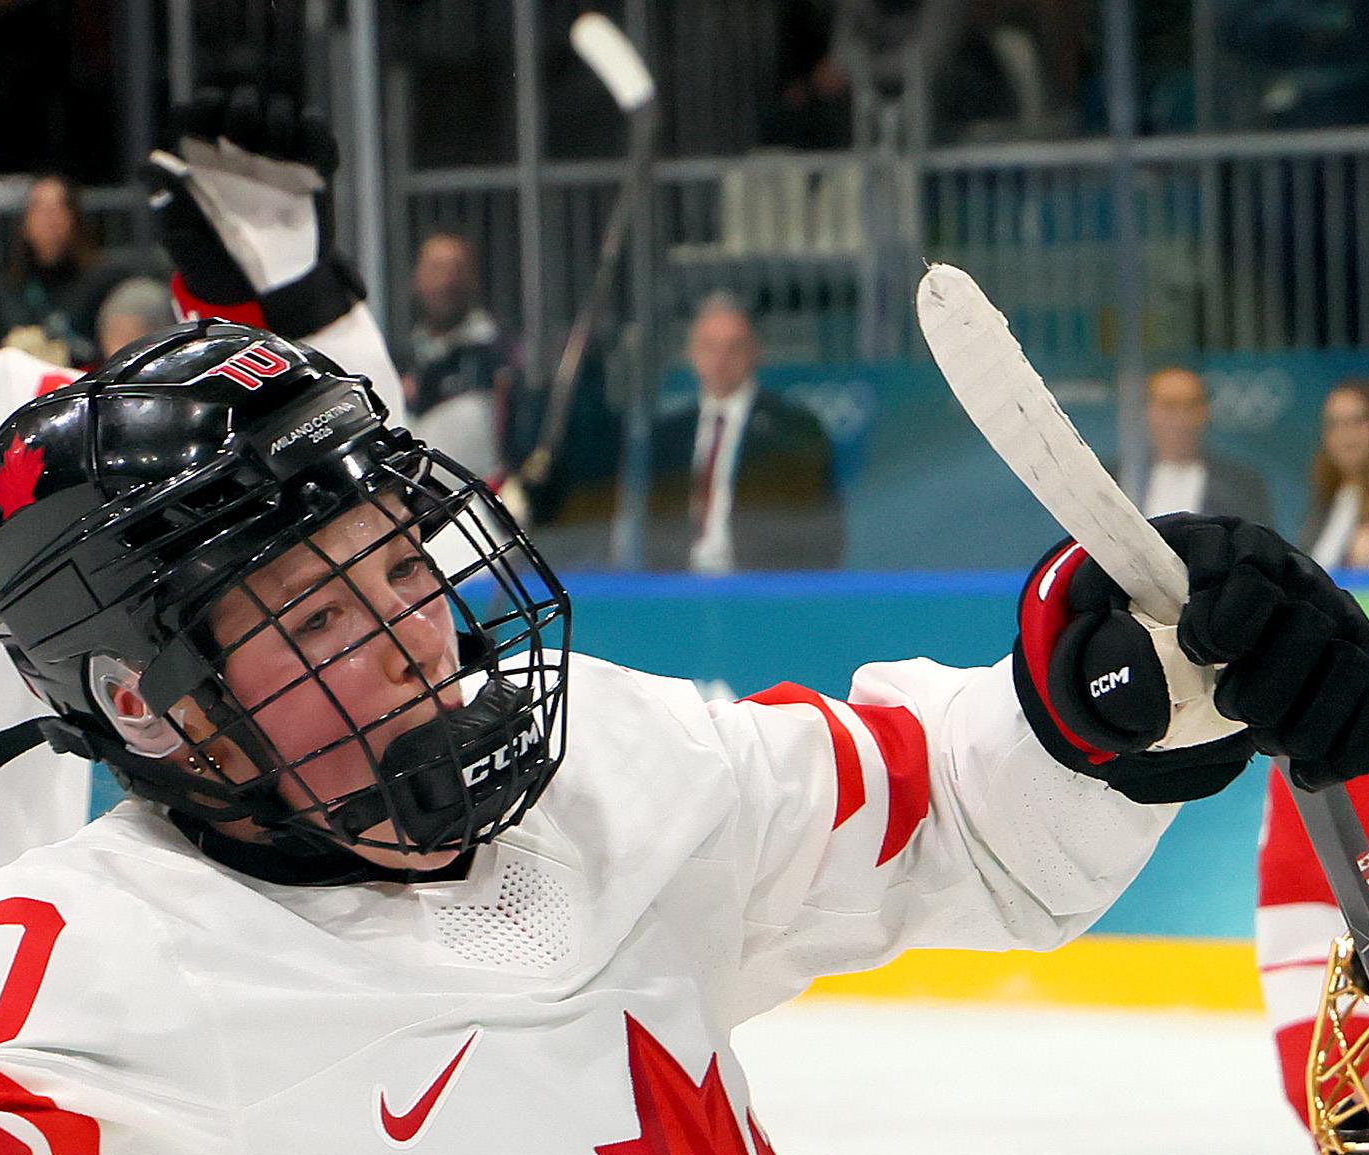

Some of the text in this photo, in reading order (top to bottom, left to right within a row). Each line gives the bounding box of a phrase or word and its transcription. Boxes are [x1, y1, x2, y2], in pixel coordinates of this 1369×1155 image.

[270, 402, 357, 456] MILANO CORTINA
[1089, 666, 1130, 699] CCM
